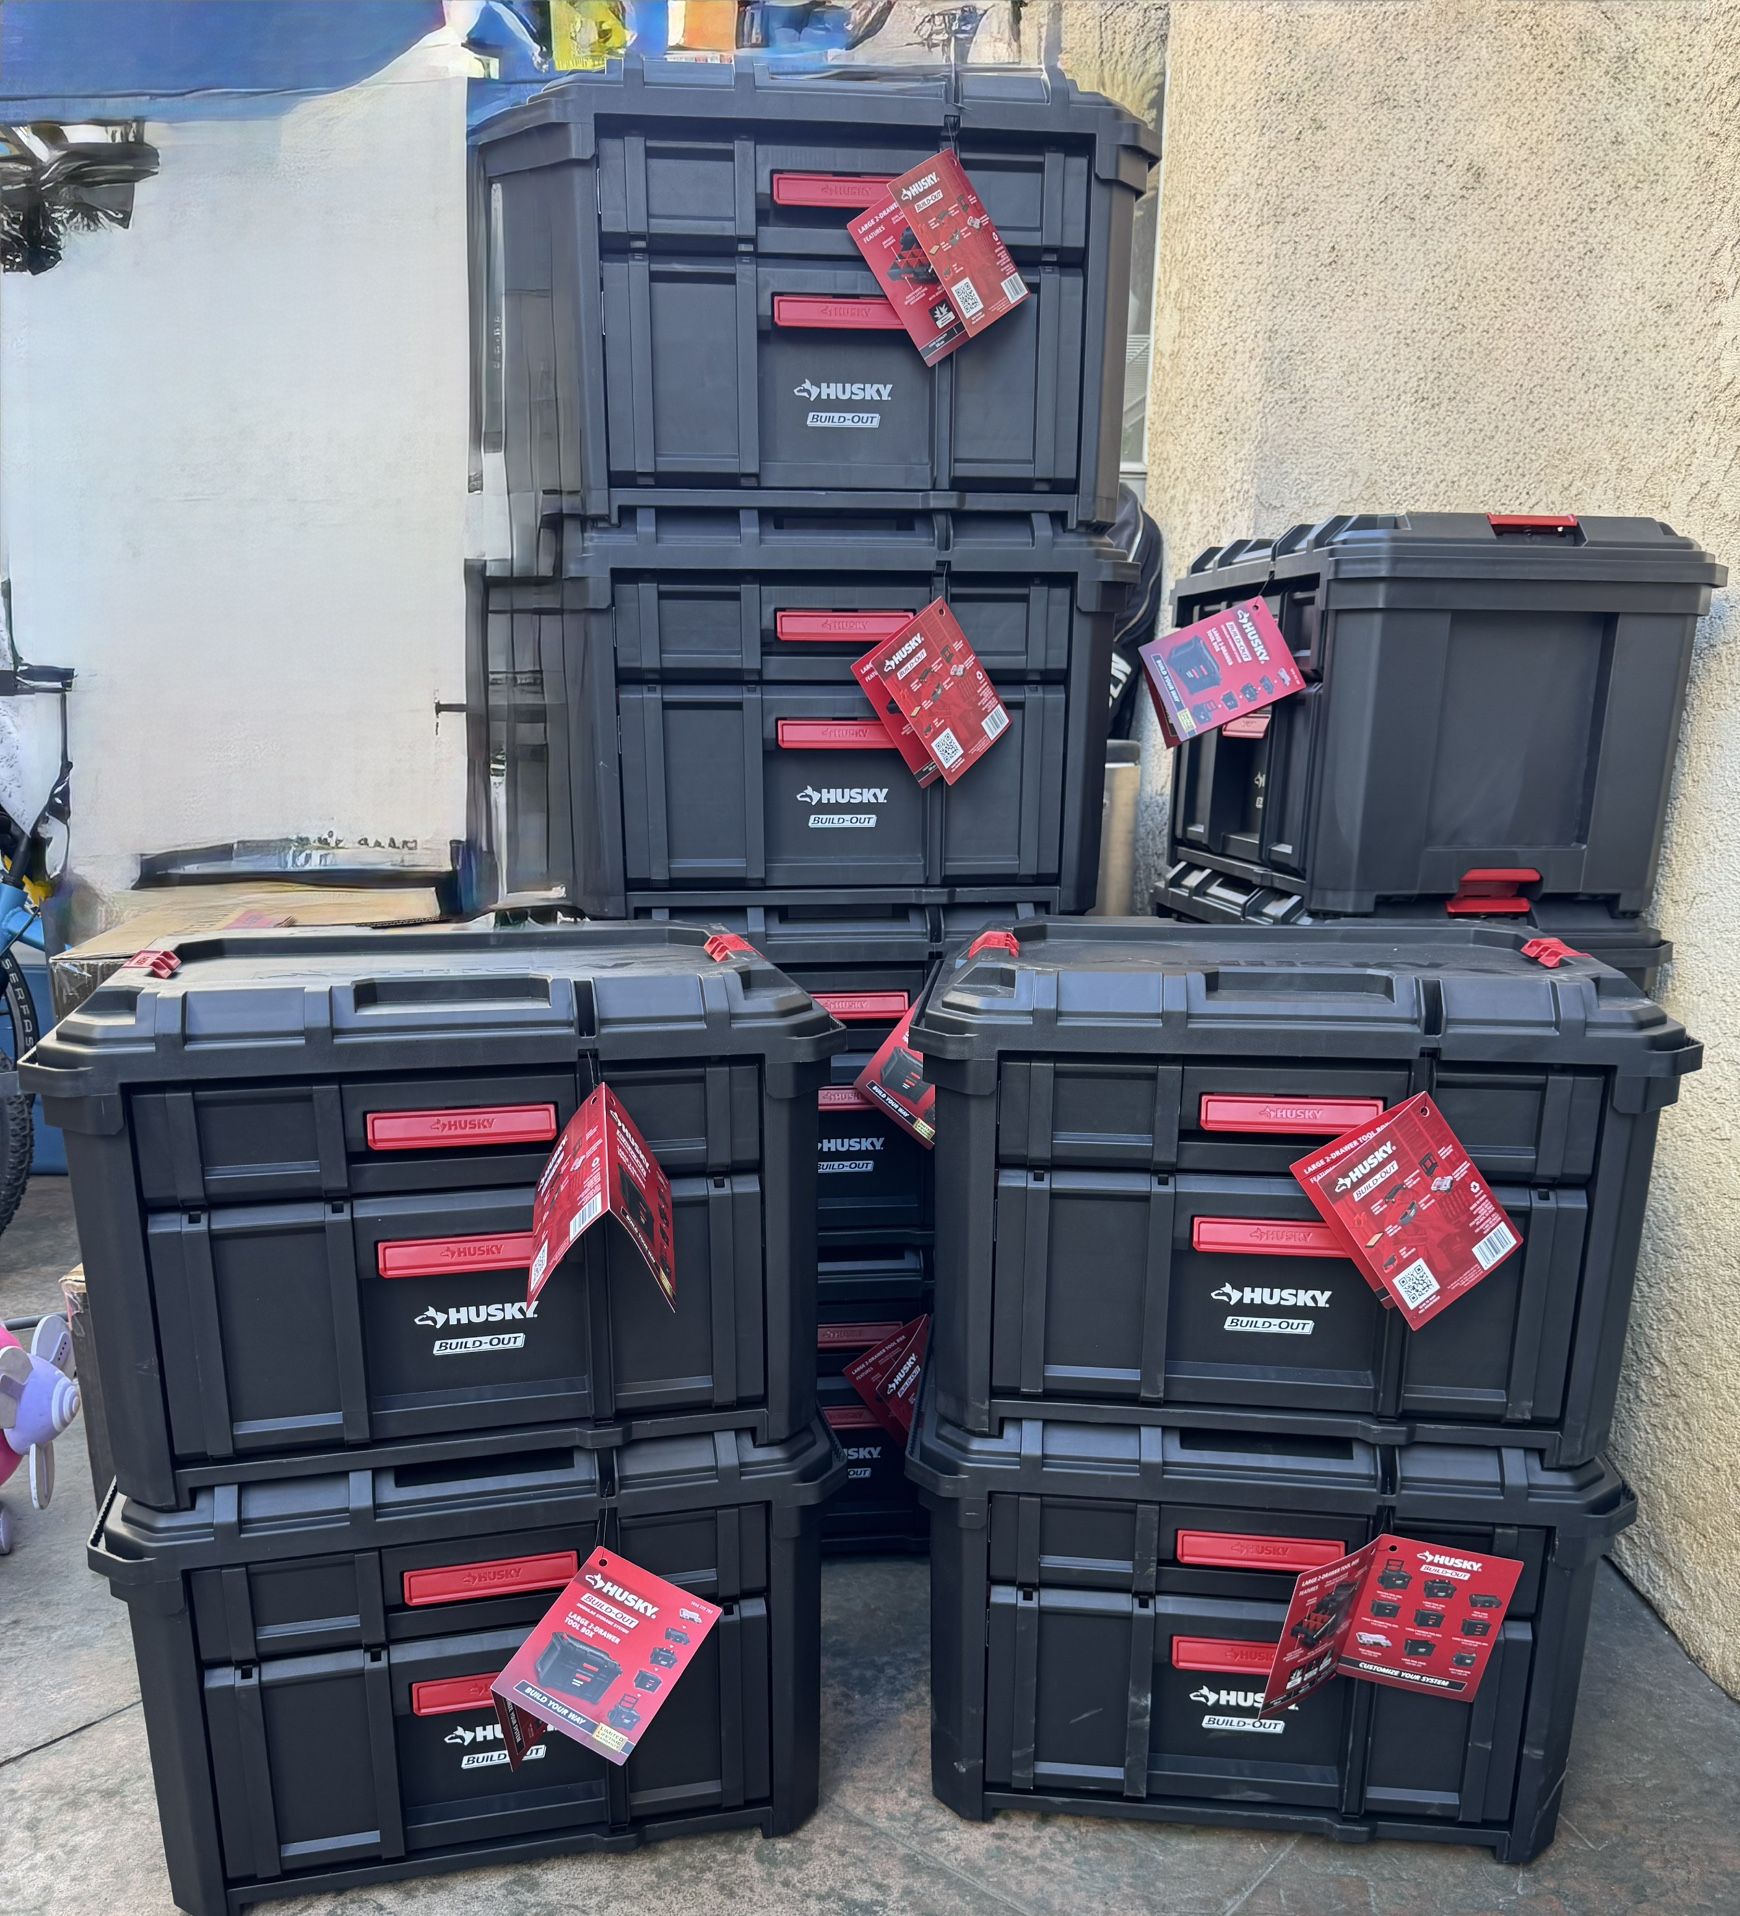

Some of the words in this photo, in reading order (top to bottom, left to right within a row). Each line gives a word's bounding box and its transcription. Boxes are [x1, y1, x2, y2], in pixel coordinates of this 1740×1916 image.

[909, 172, 939, 196] HUSKY
[916, 192, 942, 211] BUILD-OUT
[858, 219, 875, 234] LARGE
[874, 202, 899, 221] 2-DRAWE
[864, 225, 885, 243] FEATURES
[821, 383, 893, 400] HUSKY
[811, 414, 877, 425] BUILD-OUT
[892, 633, 924, 664] HUSKY
[1242, 622, 1270, 664] HUSKY
[899, 651, 925, 678] BUILD-OUT
[822, 789, 888, 803] HUSKY
[811, 817, 875, 825] BUILD-OUT
[2, 958, 34, 1047] SERFAS
[872, 1085, 886, 1099] BUILD
[886, 1097, 899, 1109] YOUR
[898, 1106, 909, 1117] WAY
[1276, 1109, 1323, 1119] HUSKY
[448, 1118, 495, 1131] HUSKY
[822, 1138, 885, 1151] HUSKY
[1304, 1159, 1326, 1174] LARGE
[1325, 1140, 1359, 1162] 2-DRAWER
[1349, 1141, 1396, 1182] HUSKY
[1355, 1163, 1396, 1198] BUILD-OUT
[1266, 1230, 1312, 1242] HUSKY
[457, 1244, 504, 1257] HUSKY
[1243, 1287, 1332, 1307] HUSKY
[449, 1301, 538, 1325] HUSKY
[1230, 1318, 1309, 1331] BUILD-OUT
[438, 1336, 520, 1350] BUILD-OUT
[852, 1364, 865, 1375] LARGE
[893, 1353, 918, 1385] HUSKY
[1246, 1545, 1290, 1556] HUSKY
[1422, 1566, 1468, 1579] BUILD-OUT
[1434, 1556, 1483, 1572] HUSKY
[477, 1568, 522, 1581] HUSKY
[1302, 1577, 1318, 1587] LARGE
[602, 1581, 659, 1619] HUSKY
[583, 1595, 637, 1627] BUILD-OUT
[565, 1617, 580, 1630] TOOL
[580, 1626, 595, 1638] BOX
[568, 1611, 590, 1627] LARGE
[588, 1621, 621, 1644] 2-DRAWER
[1359, 1662, 1400, 1676] CUSTOMIZE
[1400, 1672, 1420, 1682] YOUR
[1420, 1676, 1450, 1687] SYSTEM
[525, 1686, 548, 1703] BUILD
[547, 1700, 569, 1716] YOUR
[567, 1712, 587, 1725] WAY
[1206, 1717, 1279, 1729] BUILD-OUT
